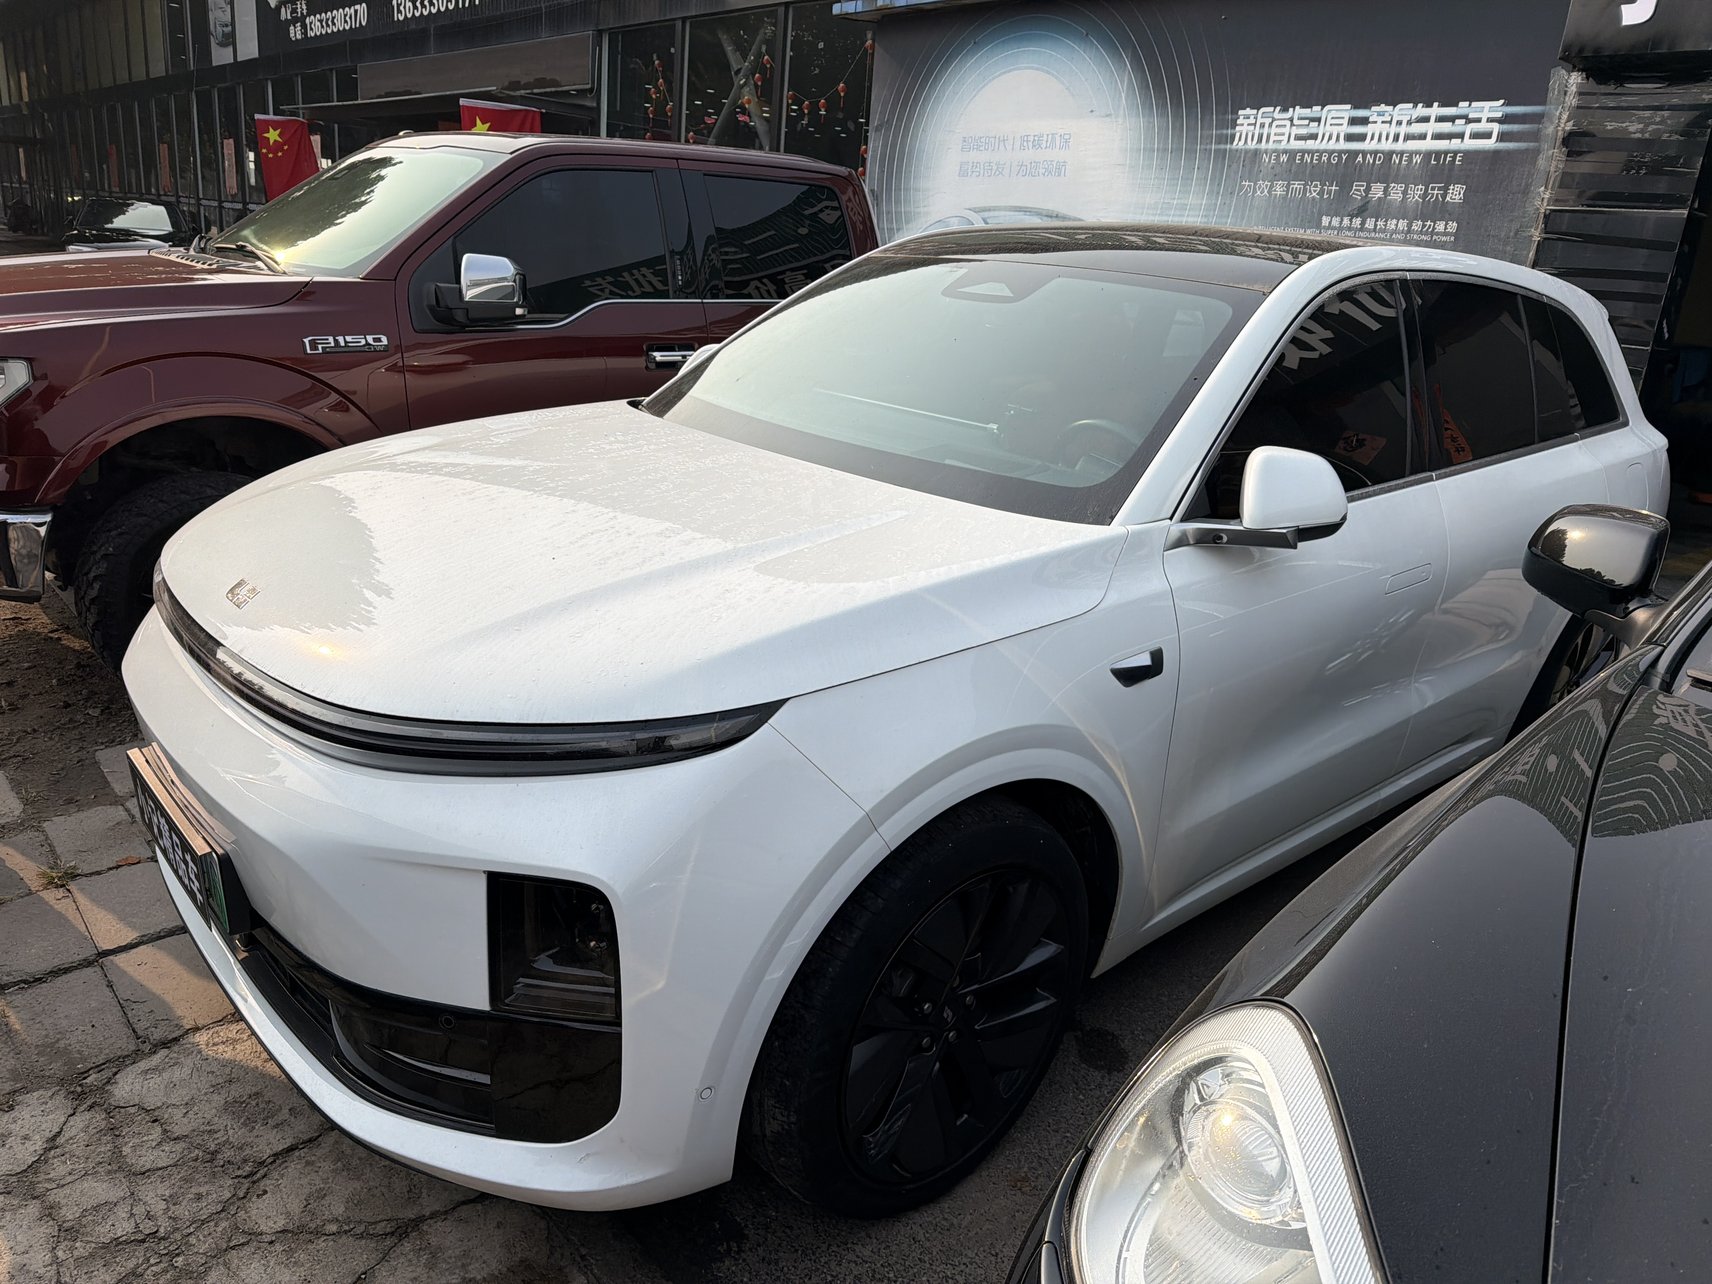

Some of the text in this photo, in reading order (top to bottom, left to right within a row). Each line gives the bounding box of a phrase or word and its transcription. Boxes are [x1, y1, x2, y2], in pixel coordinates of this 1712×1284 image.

[305, 2, 368, 38] 13633303170
[1233, 99, 1506, 147] 新能源 新生活
[961, 132, 1071, 153] 智能时代 低碳环保
[1015, 160, 1068, 177] 为您领航
[1262, 153, 1464, 165] NEW ENERGY AND NEW LIFE
[1239, 180, 1466, 203] 为效率而设计 尽享驾驶乐趣
[1321, 215, 1458, 233] 智能系统 超长续航 动力强劲
[1356, 231, 1390, 239] ENDURANCE
